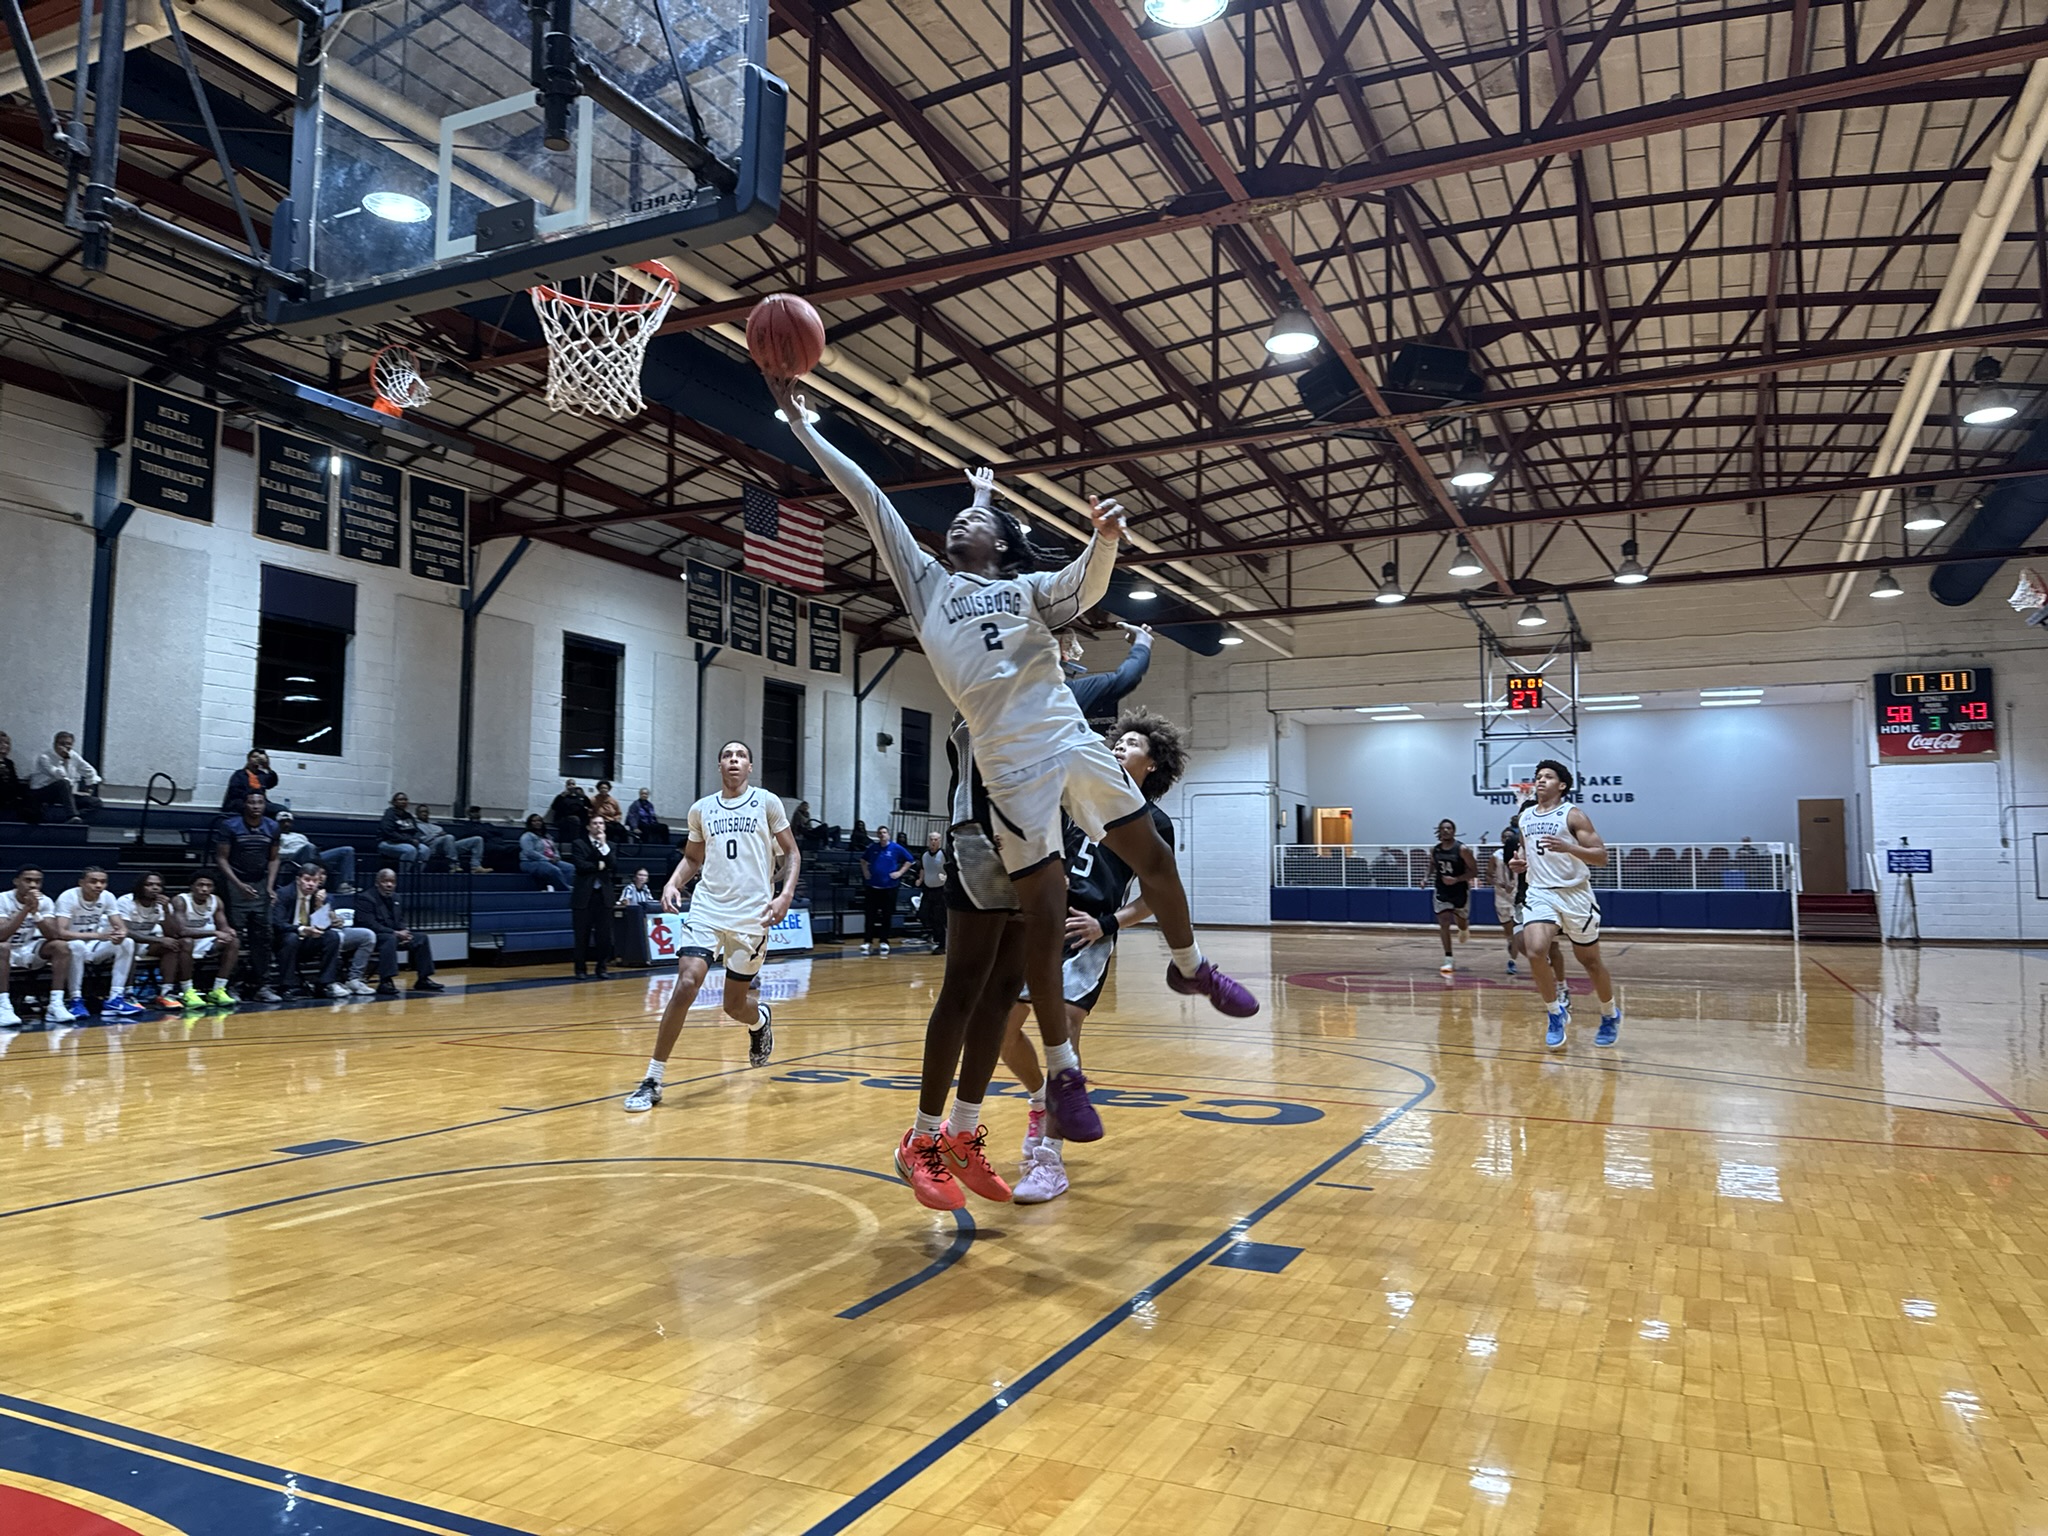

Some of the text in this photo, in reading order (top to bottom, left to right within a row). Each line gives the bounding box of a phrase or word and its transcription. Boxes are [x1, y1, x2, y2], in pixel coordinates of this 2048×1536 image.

[941, 591, 1021, 624] LOUISBURG
[980, 622, 1004, 652] 2
[1512, 691, 1538, 709] 27
[1886, 705, 1913, 723] 58
[1961, 702, 1988, 719] 43
[1881, 724, 1920, 734] HOME
[1928, 715, 1941, 730] 3
[1948, 721, 1994, 731] VISITOR
[1579, 776, 1623, 786] RAKE
[1592, 793, 1635, 803] CLUB
[708, 816, 758, 837] LOUISBURG
[726, 839, 737, 860] 0
[1536, 839, 1546, 856] 5
[1071, 836, 1099, 878] 5
[1438, 860, 1454, 874] 34
